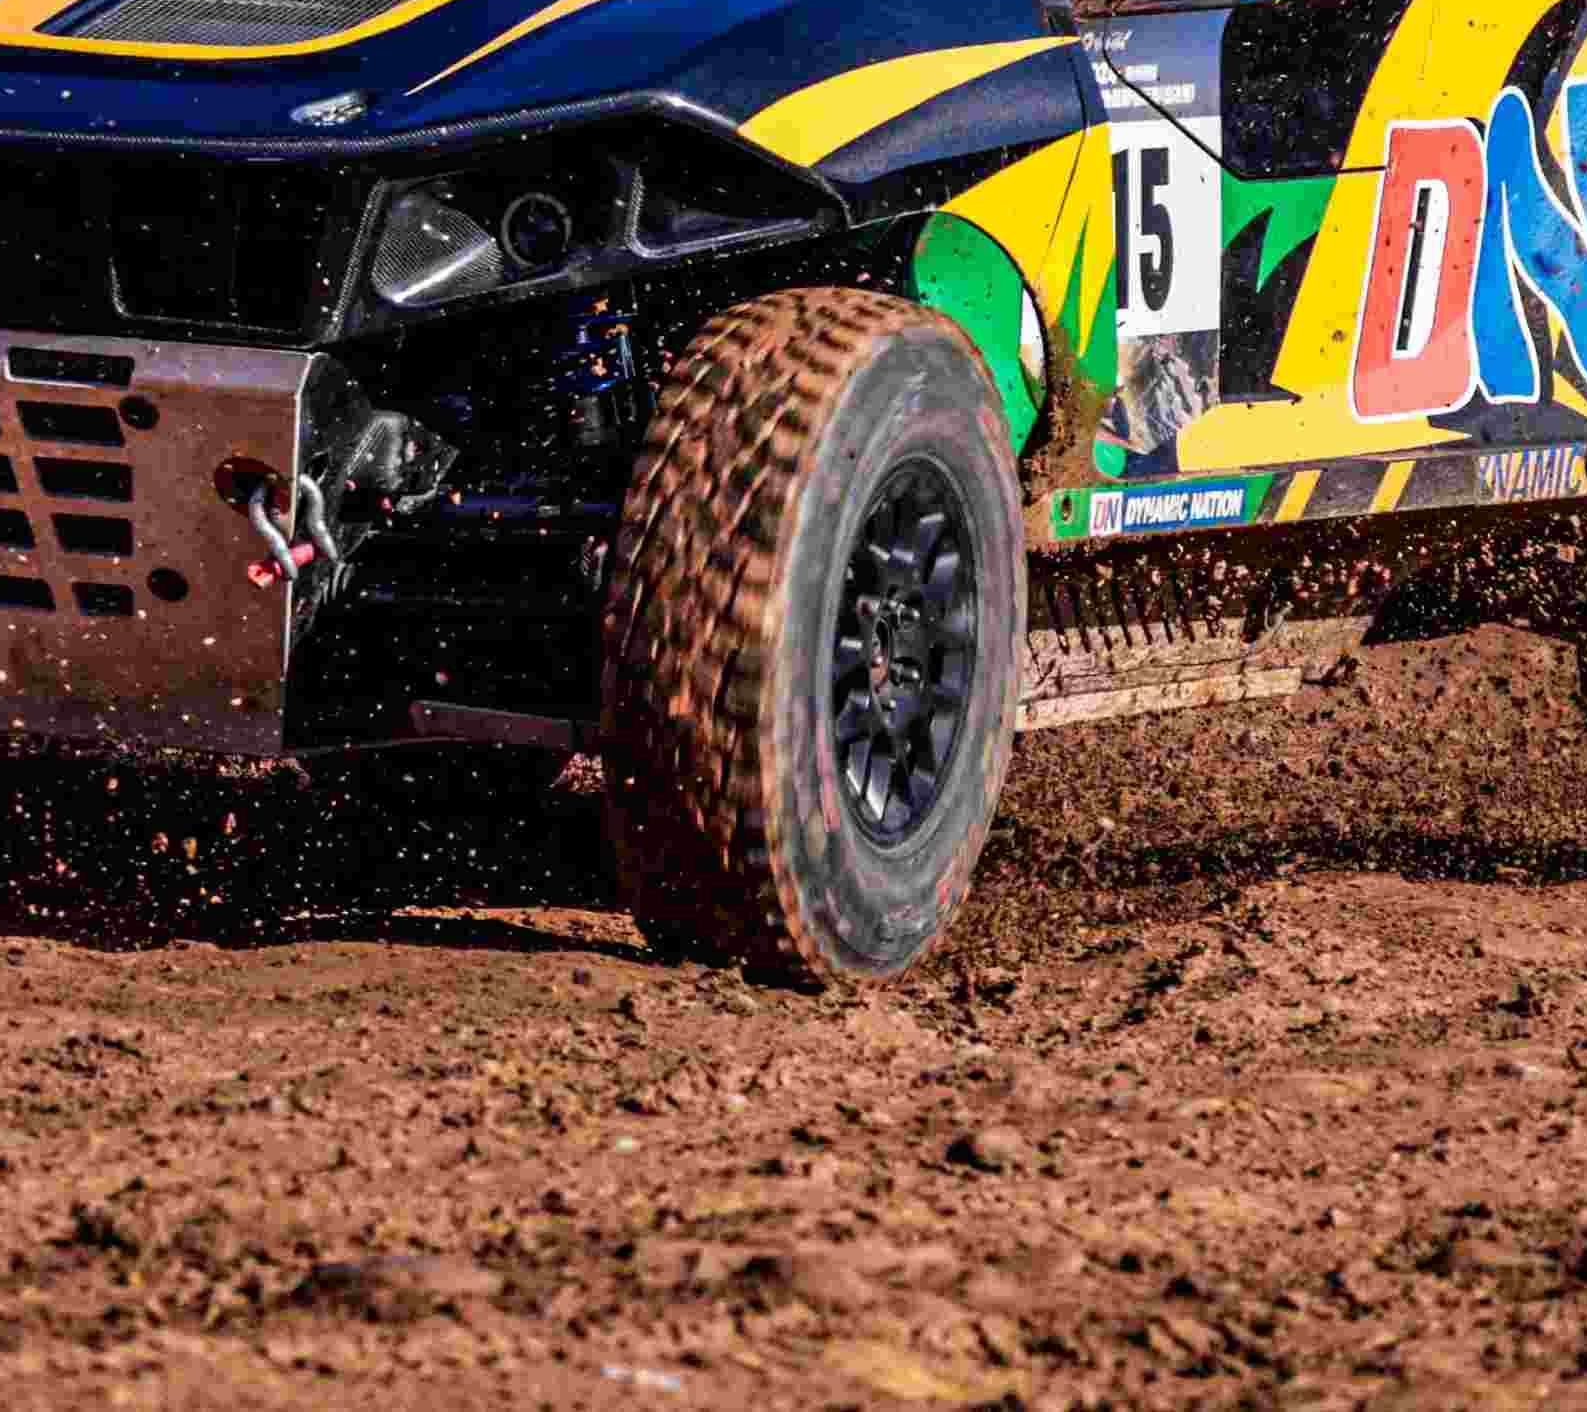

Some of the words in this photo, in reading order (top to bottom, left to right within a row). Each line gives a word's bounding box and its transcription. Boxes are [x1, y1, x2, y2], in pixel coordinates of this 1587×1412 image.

[1112, 146, 1174, 312] 15
[1124, 492, 1188, 527] DYNAMIC
[1189, 488, 1244, 520] NATION
